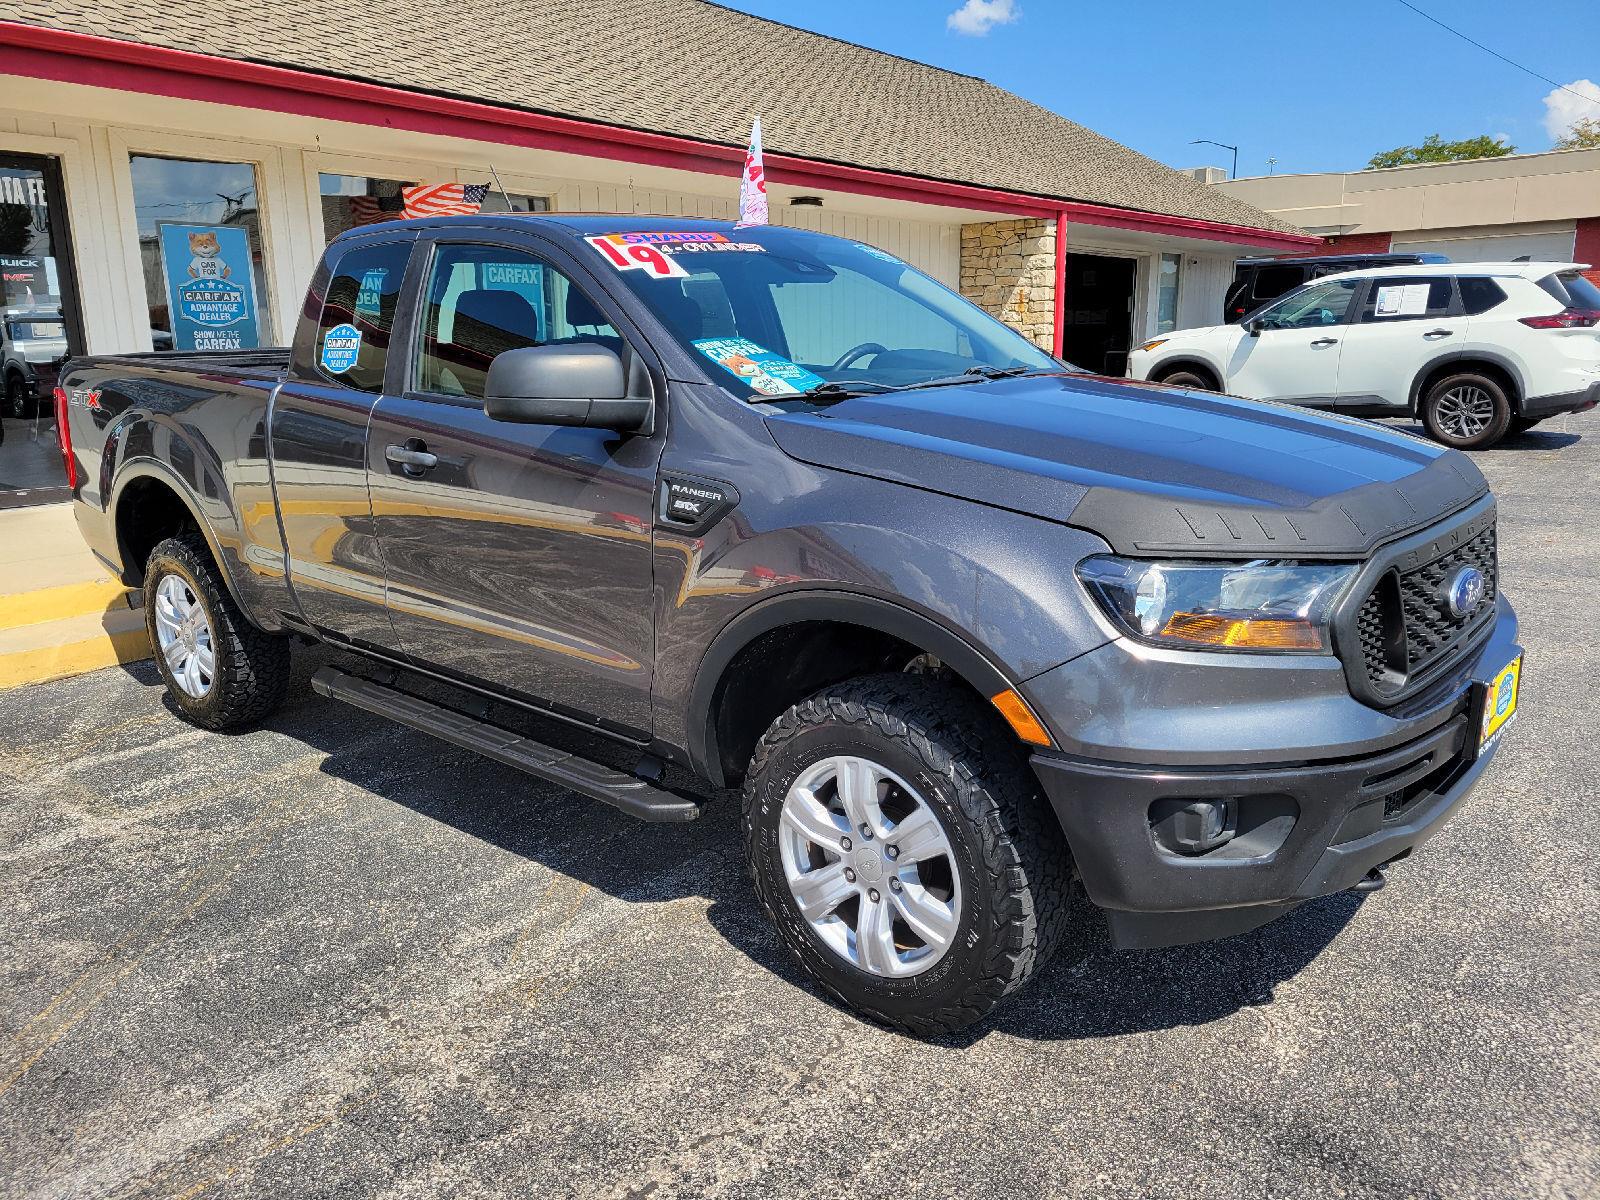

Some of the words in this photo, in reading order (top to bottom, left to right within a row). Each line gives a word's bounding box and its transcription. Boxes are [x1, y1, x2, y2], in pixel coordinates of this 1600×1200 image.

[27, 178, 47, 206] FE
[623, 233, 718, 244] SHARP
[592, 238, 671, 275] 19
[488, 266, 539, 284] CARFAX
[185, 291, 240, 301] CARFAX
[191, 303, 238, 312] ADVANTAGE
[200, 312, 231, 321] DEALER
[194, 331, 215, 339] SHOW
[195, 339, 241, 350] CARFAX
[70, 389, 102, 409] STX
[672, 484, 721, 500] RANGER
